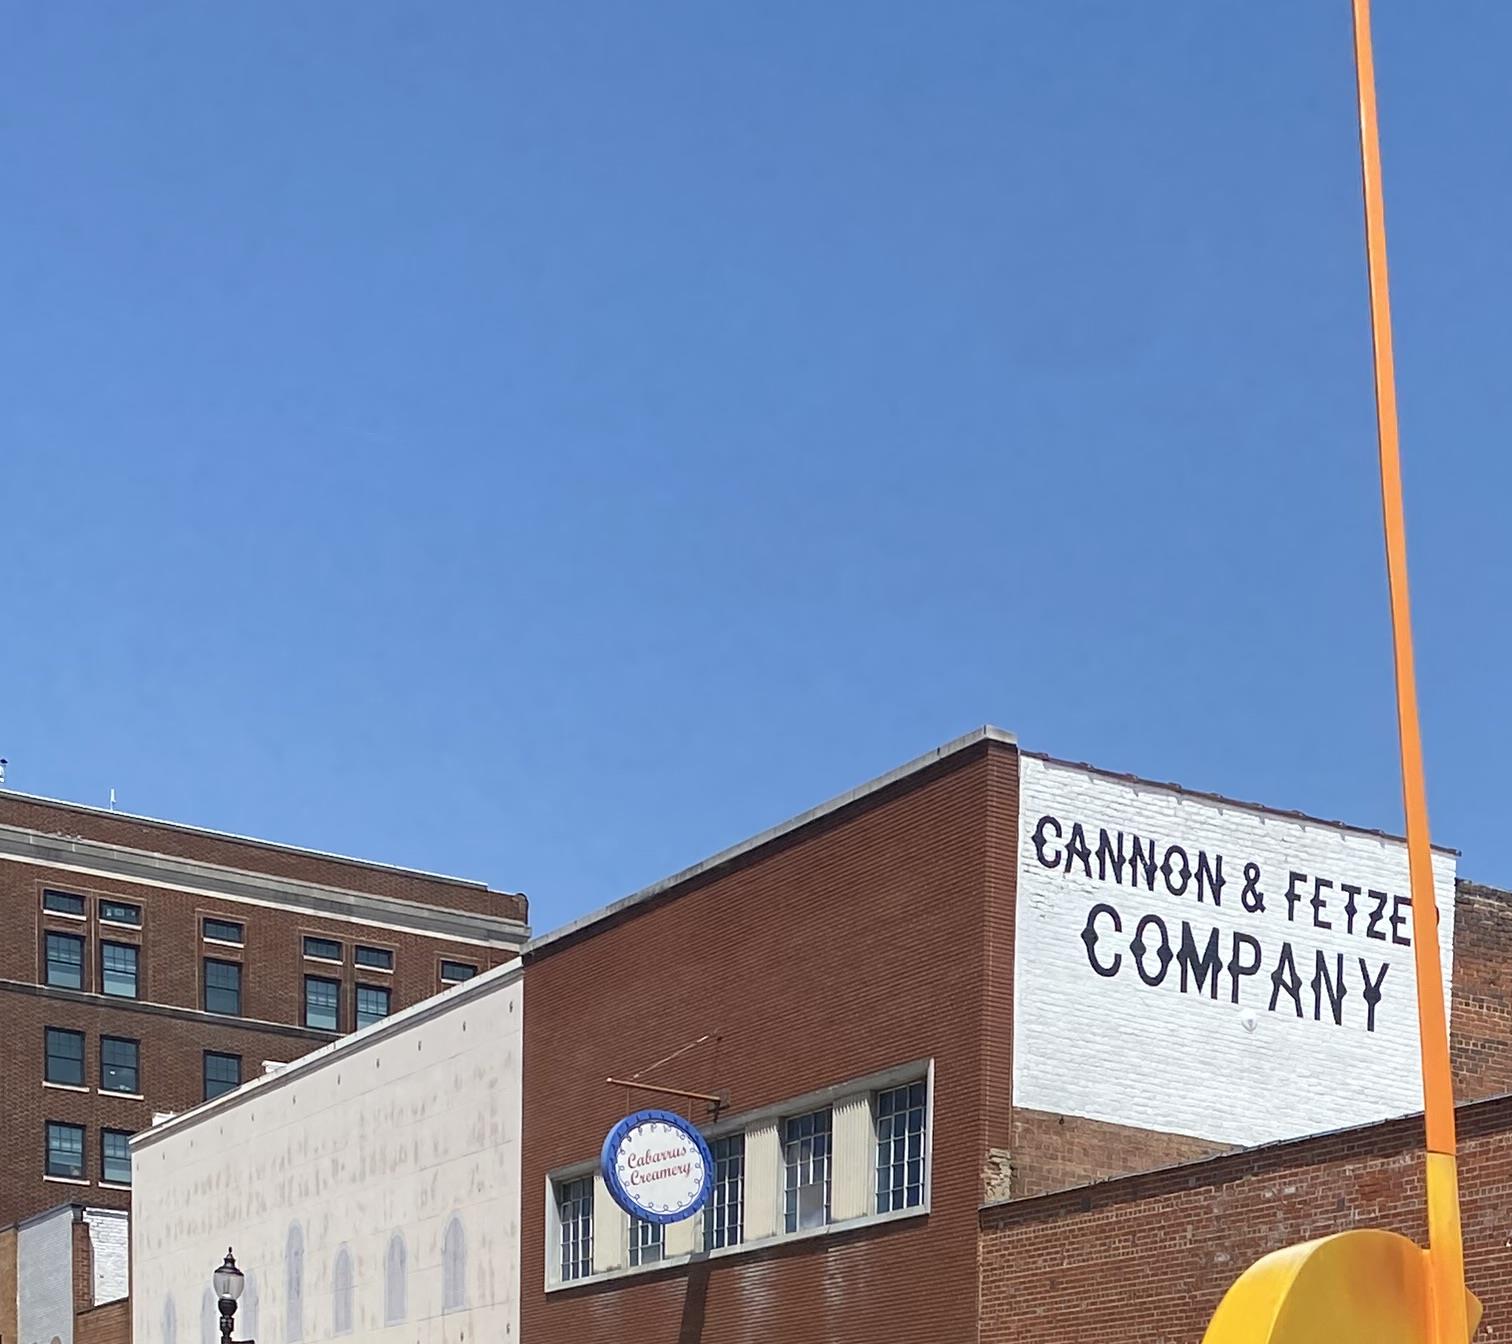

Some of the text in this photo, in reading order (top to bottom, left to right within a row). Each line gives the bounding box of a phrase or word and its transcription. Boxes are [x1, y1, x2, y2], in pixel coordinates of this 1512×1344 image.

[1031, 815, 1439, 947] CANNON & FETZE
[1081, 903, 1391, 1033] COMPANY
[627, 1146, 687, 1169] Cabarrus
[630, 1162, 692, 1186] Creamery
